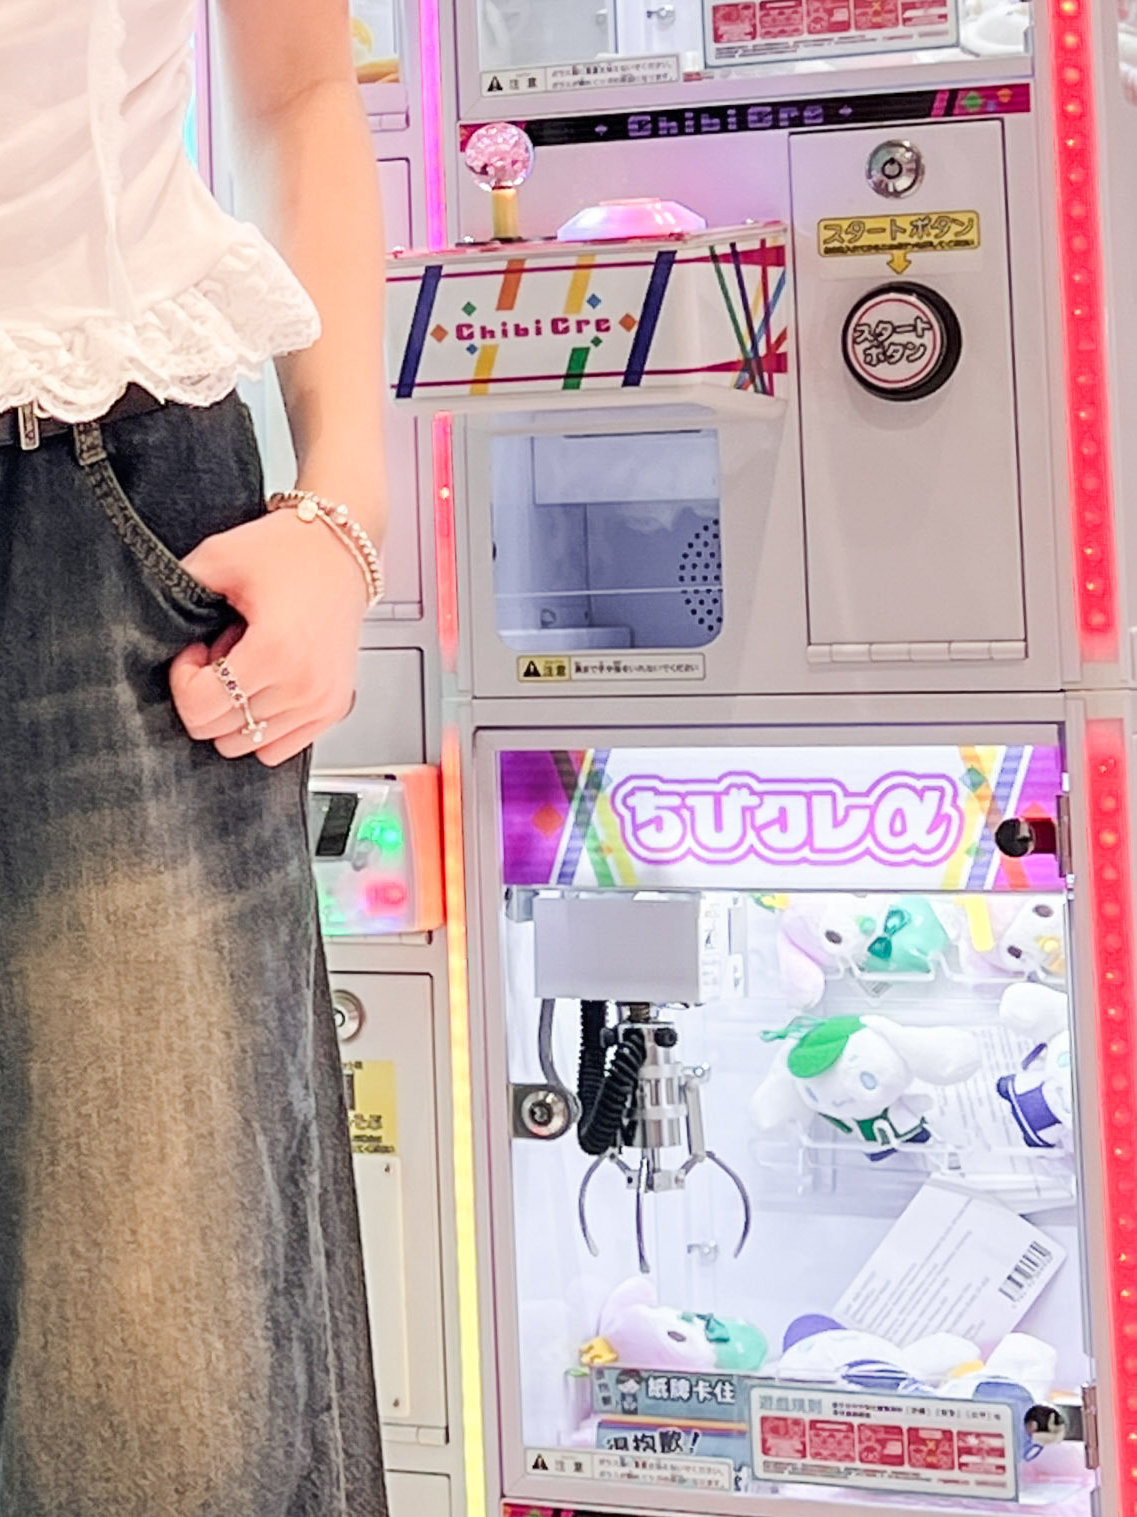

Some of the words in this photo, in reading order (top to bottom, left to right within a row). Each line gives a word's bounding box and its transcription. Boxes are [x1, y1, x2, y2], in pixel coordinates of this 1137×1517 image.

[823, 216, 974, 244] スタートボタン
[853, 316, 933, 344] スタート
[863, 341, 928, 367] ボタン
[616, 774, 961, 864] ちびクレα
[646, 1376, 736, 1403] 紙牌卡住
